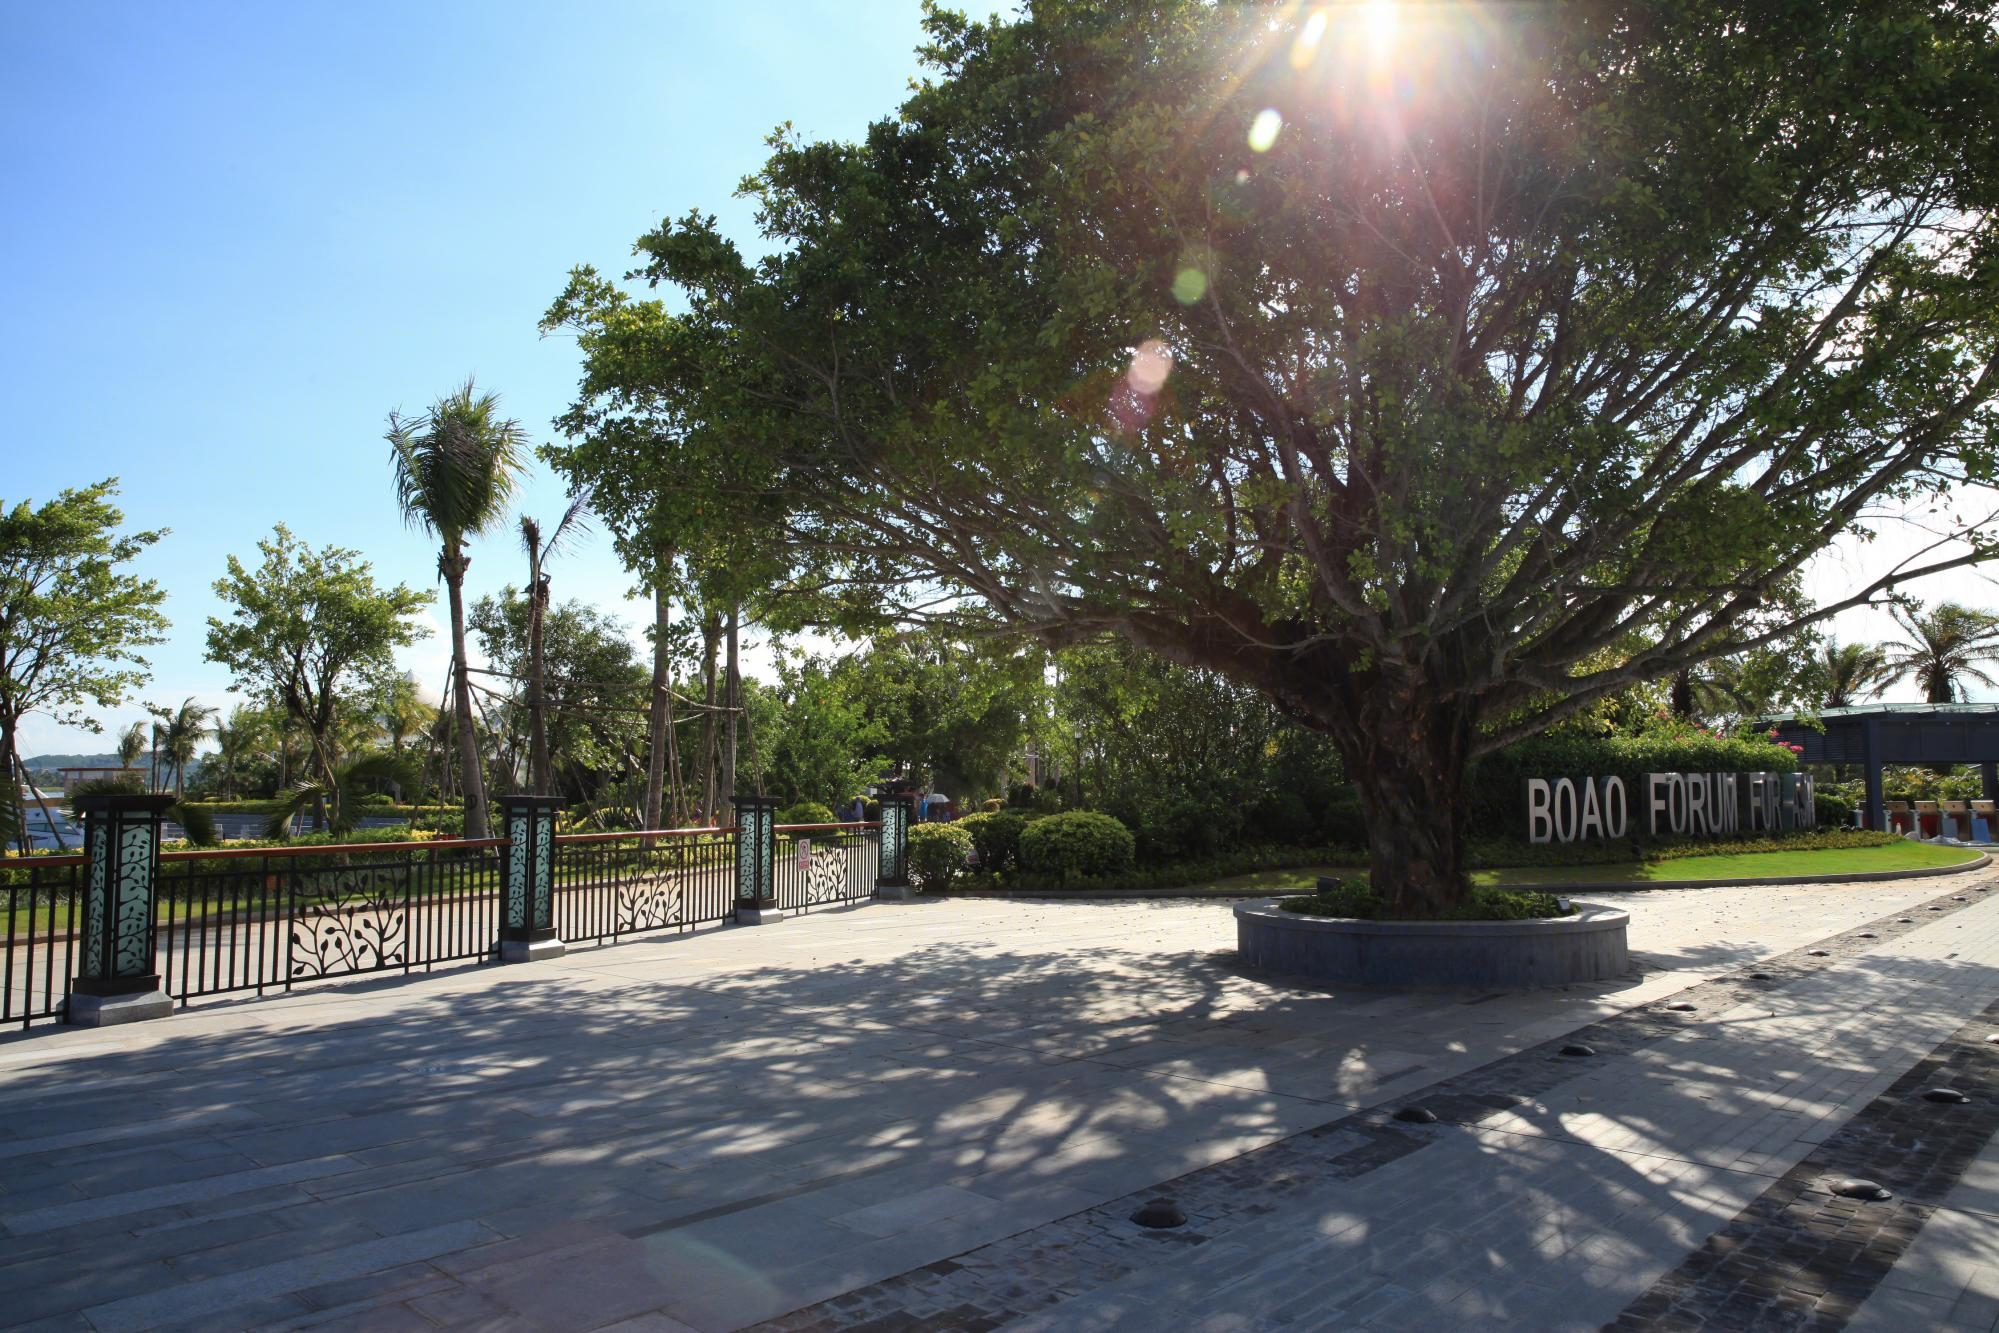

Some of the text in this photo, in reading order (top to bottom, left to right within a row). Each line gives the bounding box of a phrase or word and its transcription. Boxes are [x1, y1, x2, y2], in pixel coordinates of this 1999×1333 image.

[1528, 776, 1627, 844] BOAO
[1650, 772, 1738, 836] FORUM
[1749, 772, 1783, 831] FOR
